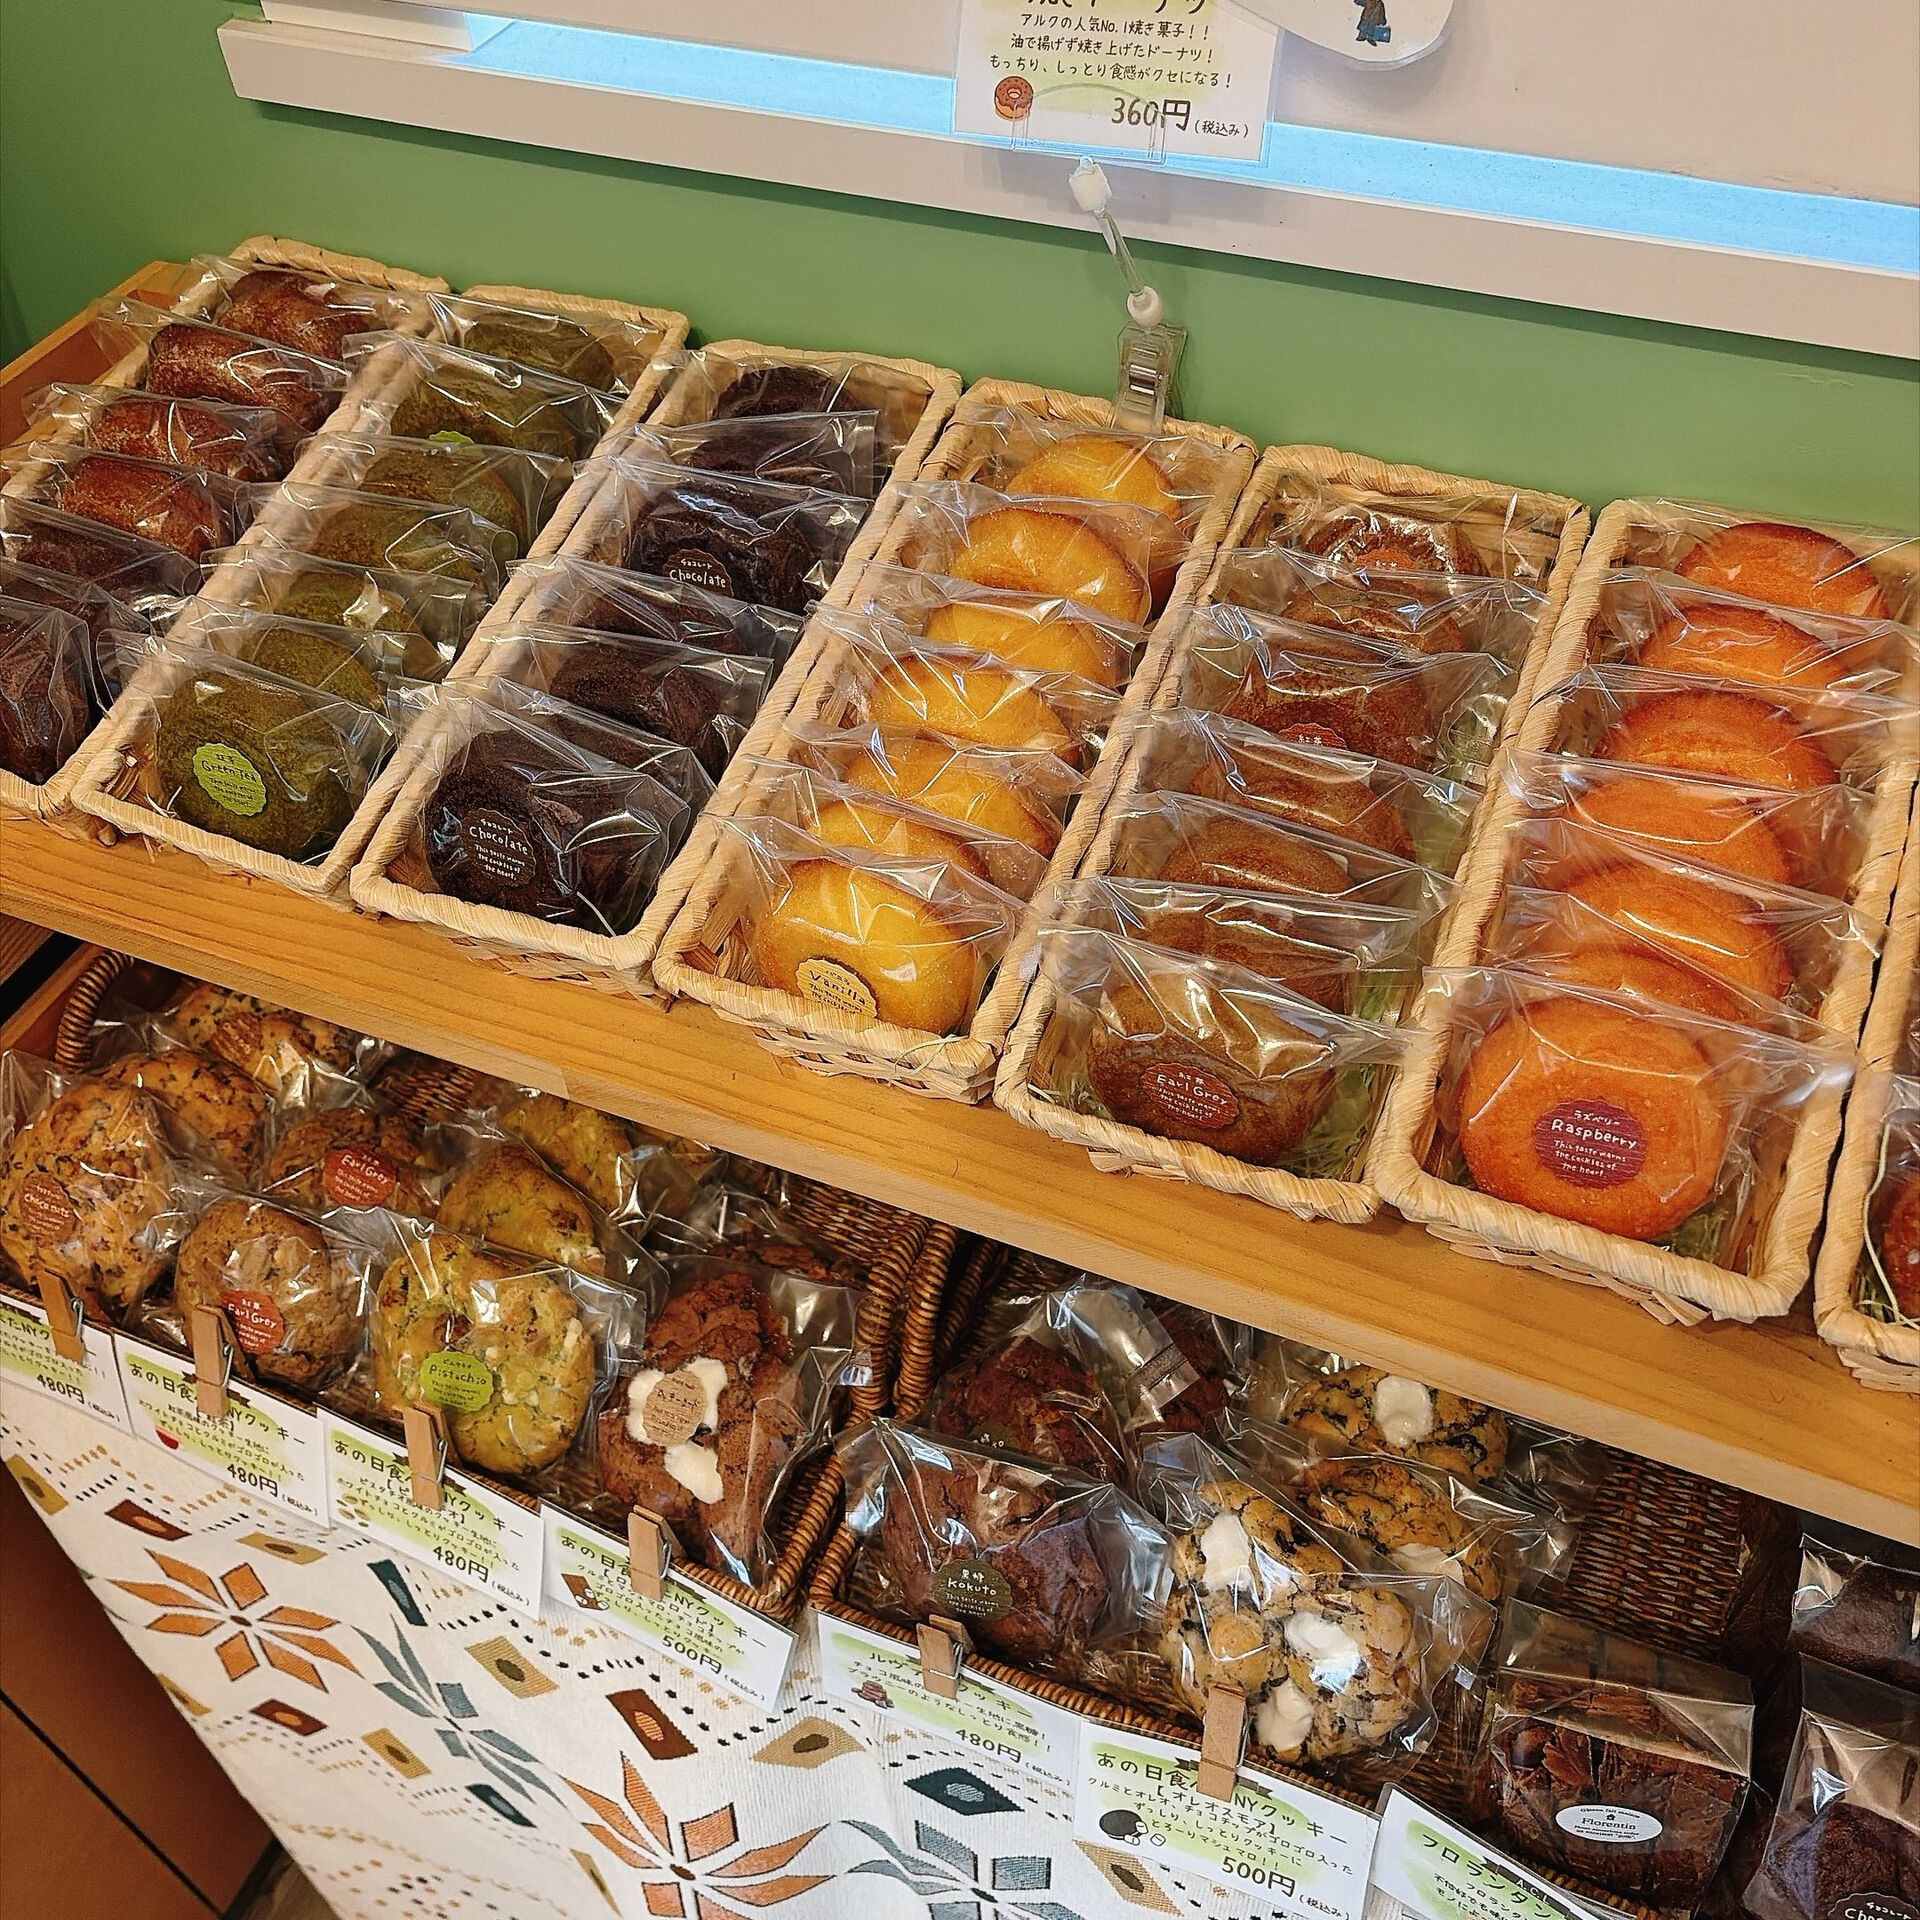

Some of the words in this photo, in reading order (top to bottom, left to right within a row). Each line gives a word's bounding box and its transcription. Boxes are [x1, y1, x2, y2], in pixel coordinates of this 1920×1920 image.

[1010, 33, 1213, 64] 油で揚げず焼き上げたドーナツ！
[990, 54, 1231, 88] もっちり、しっとり食感がクセになる！
[1111, 97, 1191, 131] 360円
[1194, 120, 1249, 138] (税込み)
[669, 569, 726, 588] Chocolate
[201, 760, 236, 776] Green
[469, 826, 528, 855] Chocolate
[809, 970, 866, 1005] Vanilla
[1157, 1074, 1189, 1091] Earl
[1193, 1086, 1228, 1105] Grey
[1551, 1118, 1637, 1150] Raspberry
[251, 1312, 277, 1329] Grey
[37, 1374, 85, 1404] 480円
[429, 1364, 487, 1385] Pistachio
[129, 1363, 306, 1445] あの日食NYクッキー
[227, 1463, 278, 1498] 480円
[433, 1546, 489, 1583] 480円
[947, 1577, 997, 1596] Kokuto
[661, 1635, 723, 1674] 500円
[956, 1729, 1022, 1763] 480円
[1096, 1751, 1347, 1845] あの日食NYクッキー
[1156, 1786, 1276, 1835] 【オレオスモア】
[1134, 1801, 1302, 1867] ずっしり、しっとりクッキーに
[1581, 1817, 1636, 1830] Florentin
[1151, 1819, 1280, 1871] とろーりマシュマロ！！
[1221, 1856, 1297, 1897] 500円
[1422, 1834, 1551, 1918] フロランタン
